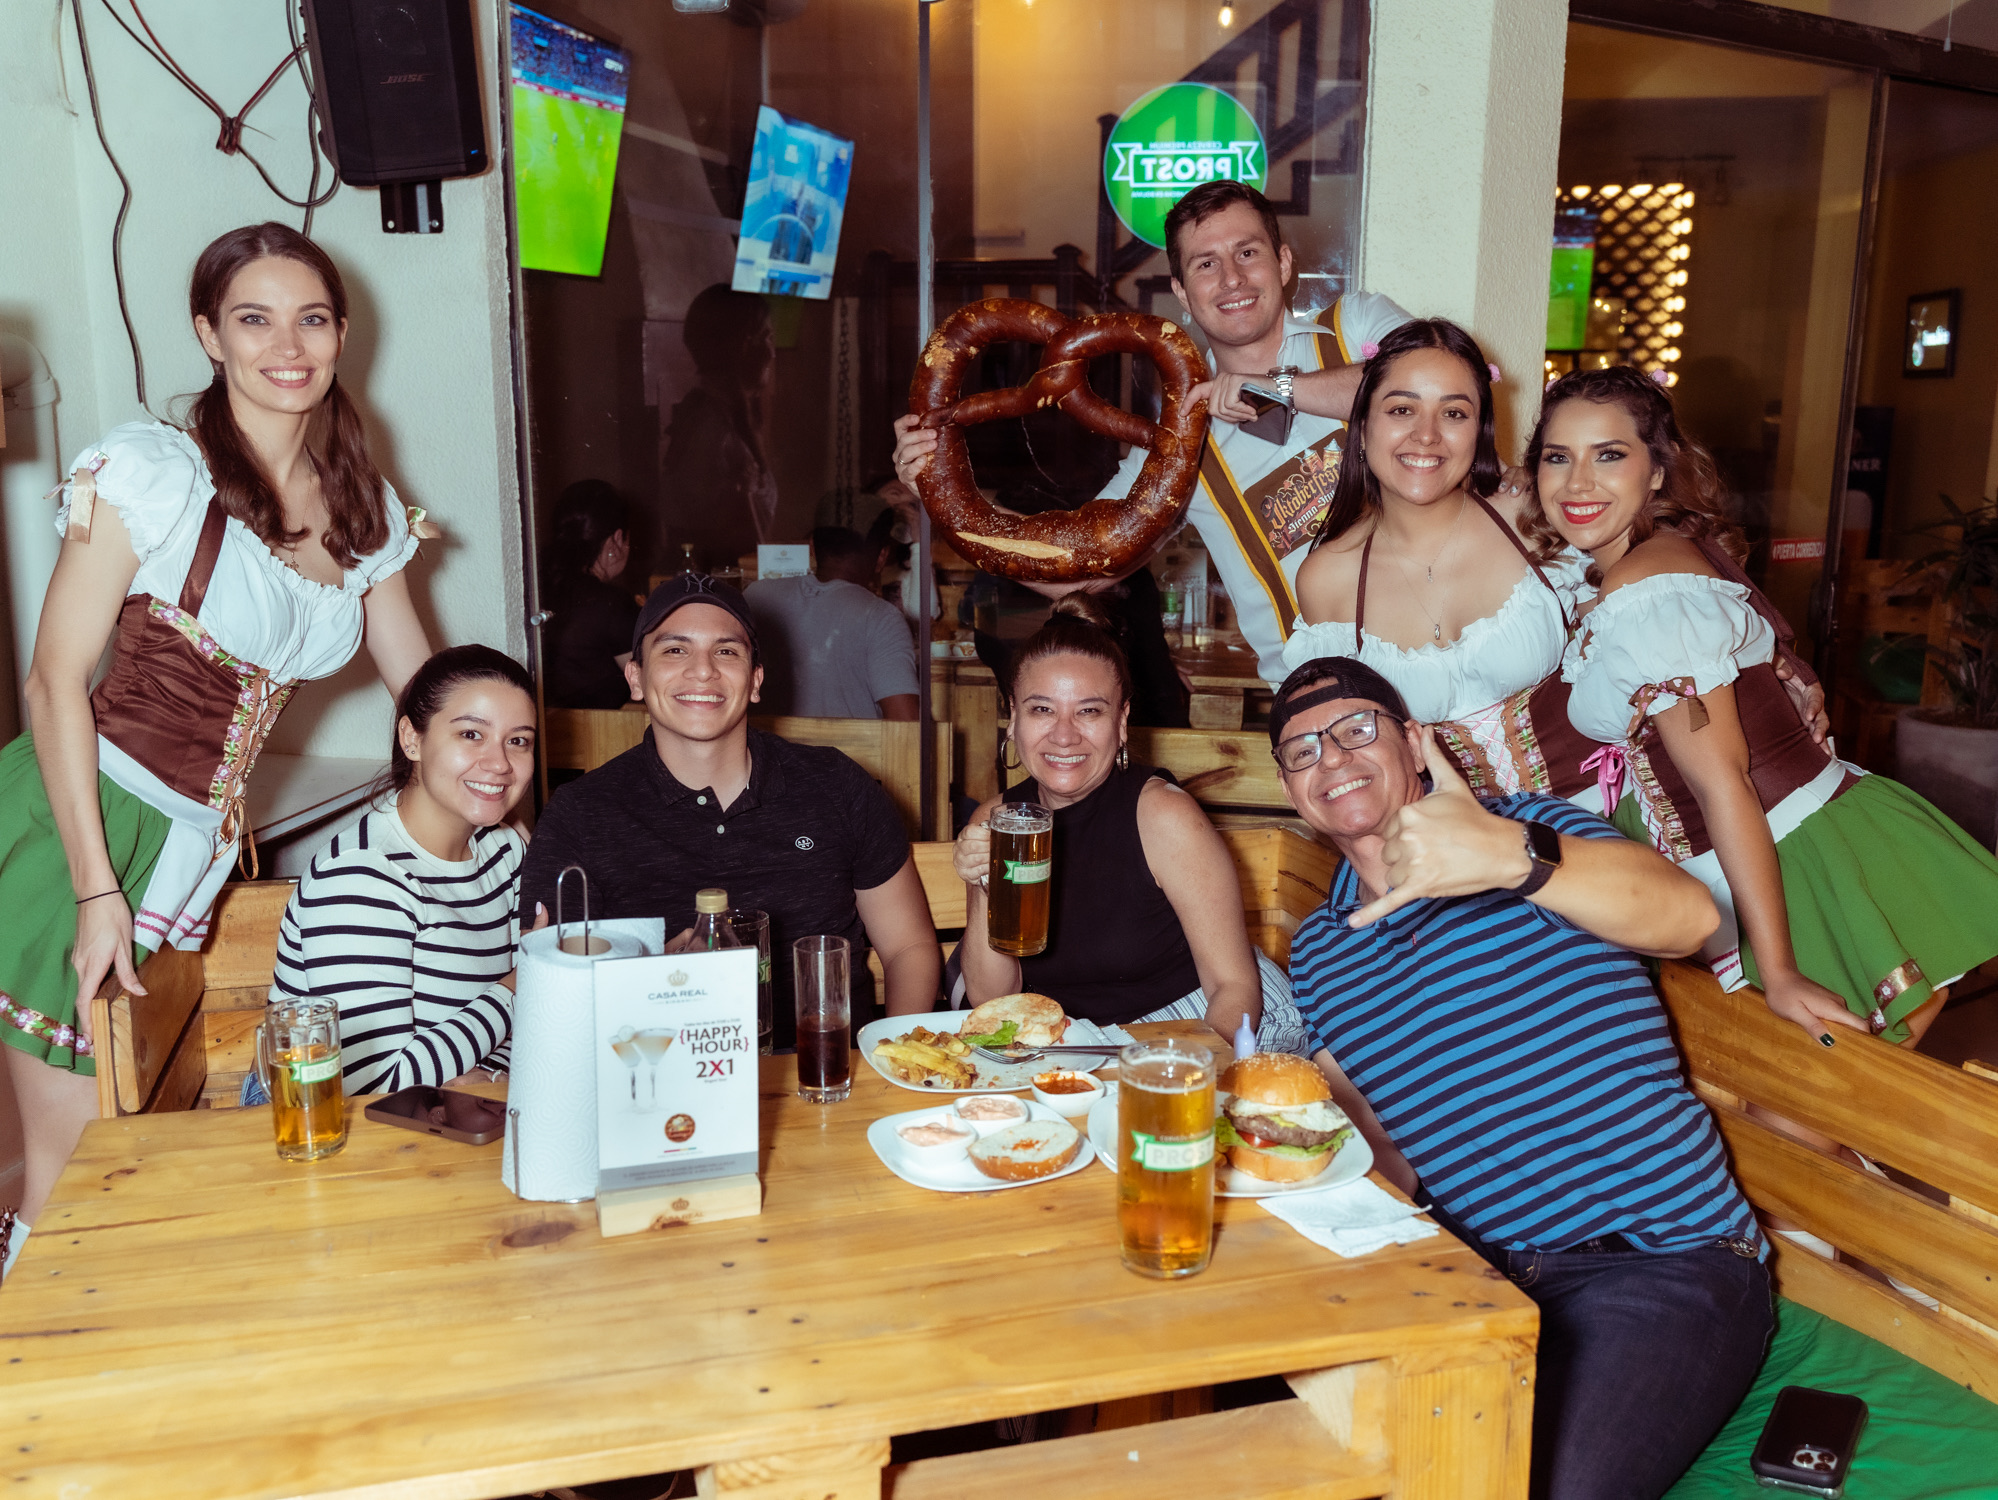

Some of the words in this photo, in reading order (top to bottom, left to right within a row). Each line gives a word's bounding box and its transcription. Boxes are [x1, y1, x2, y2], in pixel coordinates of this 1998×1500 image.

[380, 74, 430, 85] BOSE
[1776, 543, 1796, 560] PUERTA
[684, 573, 715, 594] NY
[1018, 864, 1050, 881] PROS
[648, 992, 677, 1001] CASA
[680, 989, 708, 998] REAL
[307, 1058, 341, 1079] PROS
[696, 1058, 734, 1079] 2X1
